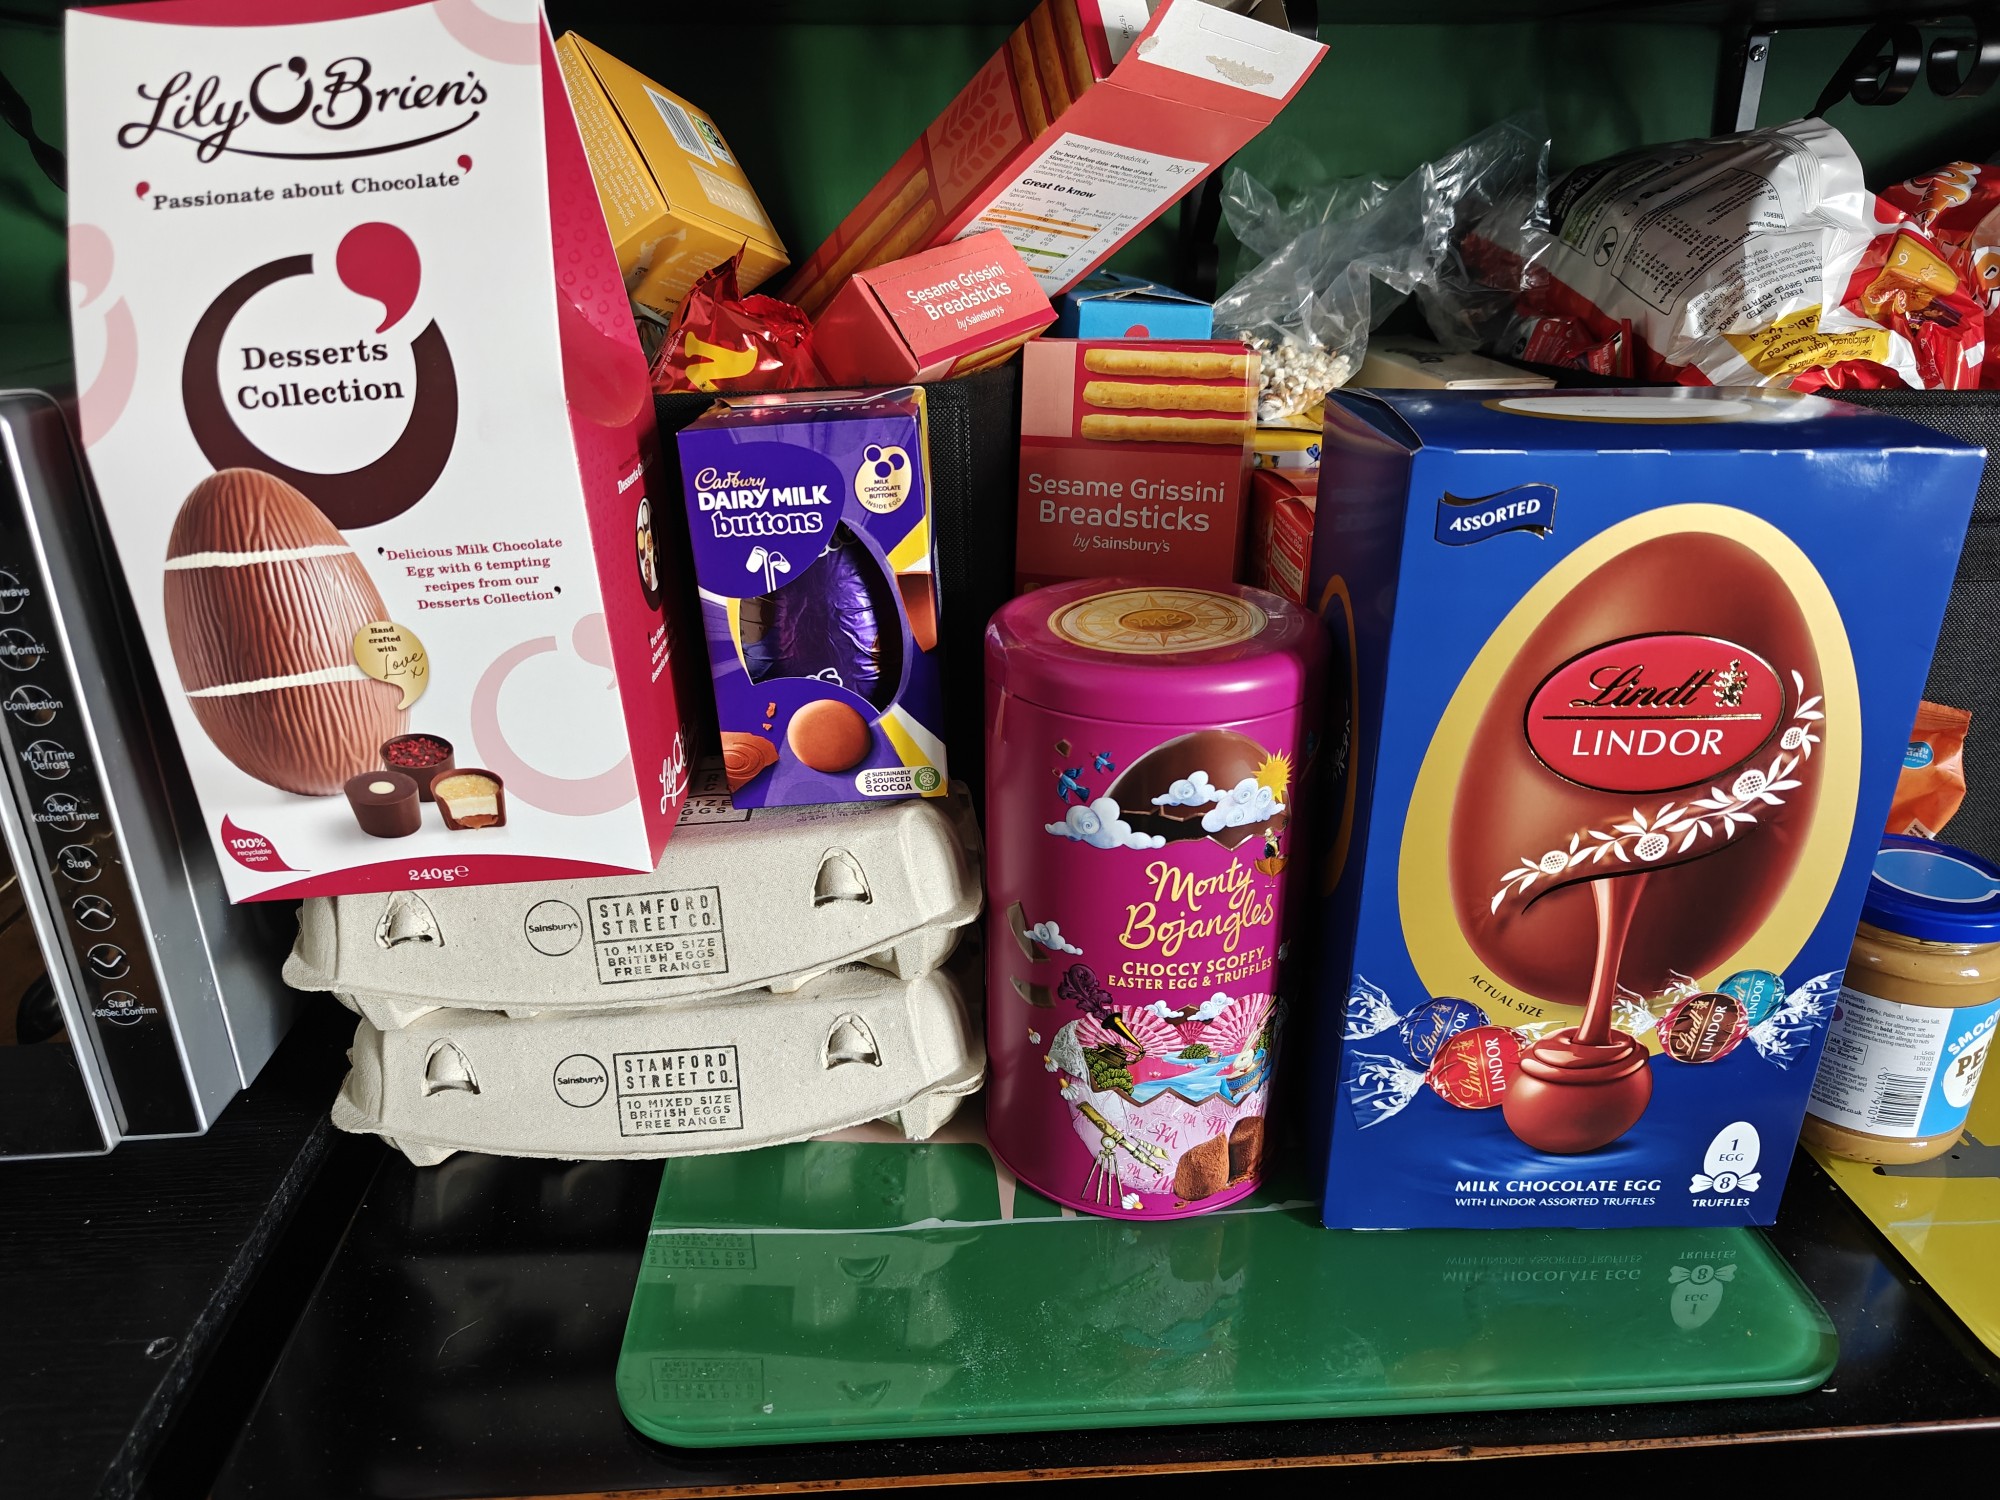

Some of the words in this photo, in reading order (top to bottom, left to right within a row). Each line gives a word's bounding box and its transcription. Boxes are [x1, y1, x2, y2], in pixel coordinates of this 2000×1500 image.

[118, 71, 249, 163] Lily
[1064, 140, 1090, 152] Sesame
[1113, 151, 1150, 164] breadsticks
[153, 188, 274, 210] Passionate
[283, 181, 344, 200] about
[352, 173, 459, 193] Chocolate
[1022, 178, 1053, 190] Great
[1055, 184, 1065, 192] to
[1066, 187, 1096, 198] know
[907, 279, 960, 304] Sesame
[958, 261, 1005, 286] Grissini
[1774, 280, 1802, 294] SHAPED
[923, 282, 1011, 321] Breadsticks
[1741, 292, 1772, 311] POTATO
[1779, 287, 1804, 301] READY
[956, 318, 968, 331] by
[965, 304, 1004, 325] Sainsbury's
[1715, 310, 1740, 332] SNACK
[241, 338, 388, 370] Desserts
[237, 379, 405, 410] Collection
[716, 409, 791, 419] HAPPY
[803, 404, 886, 413] EASTER
[694, 467, 766, 492] Cadbury
[1028, 473, 1123, 498] Sesame
[1130, 479, 1225, 503] Grissini
[698, 488, 770, 511] DAIRY
[773, 485, 832, 507] MILK
[865, 500, 887, 509] INSIDE
[889, 498, 902, 508] EGG
[712, 511, 824, 538] buttons
[1039, 500, 1210, 532] Breadsticks
[1449, 498, 1541, 533] ASSORTED
[387, 548, 453, 561] Delicious
[457, 544, 489, 556] Milk
[493, 538, 562, 553] Chocolate
[1072, 533, 1091, 552] by
[1092, 536, 1170, 554] Sainsbury's
[406, 566, 434, 578] Egg
[439, 562, 470, 574] with
[475, 562, 483, 571] 6
[487, 556, 551, 571] tempting
[425, 581, 475, 593] recipes
[479, 577, 512, 588] from
[516, 575, 539, 585] our
[418, 596, 480, 610] Desserts
[484, 591, 554, 605] Collection
[369, 635, 401, 644] crafted
[370, 626, 394, 634] Hand
[377, 645, 397, 653] with
[384, 652, 424, 679] Love
[1569, 665, 1717, 708] Lindt
[3, 700, 63, 711] Convection
[1572, 729, 1724, 756] LINDOR
[31, 760, 70, 770] Defrost
[865, 772, 873, 792] 100%
[873, 776, 911, 784] SOURCED
[874, 783, 912, 792] COCOA
[46, 802, 78, 812] Clock/
[31, 813, 68, 822] Kitchen
[68, 812, 100, 820] Timer
[230, 837, 267, 850] 100%
[236, 847, 272, 858] recyclable
[67, 859, 92, 869] Stop
[244, 855, 269, 863] carton
[1145, 857, 1254, 912] Monty
[600, 895, 709, 918] STAMFORD
[528, 923, 578, 934] Sainsbury's
[602, 916, 678, 936] STREET
[689, 912, 716, 928] CO.
[1118, 889, 1274, 957] Bojangles
[604, 947, 619, 956] 10
[627, 942, 674, 954] MIXED
[682, 938, 716, 949] SIZE
[608, 953, 668, 967] BRITISH
[676, 949, 715, 959] EGGS
[1122, 962, 1202, 976] CHOCCY
[1207, 946, 1265, 973] SCOFFY
[614, 966, 652, 977] FREE
[659, 960, 711, 972] RANGE
[1108, 975, 1163, 990] EASTER
[1168, 977, 1198, 990] EGG
[1202, 975, 1211, 987] &
[1216, 957, 1272, 985] TRUFFLES
[108, 999, 134, 1008] Start/
[1469, 974, 1513, 1008] ACTUAL
[1515, 1002, 1545, 1018] SIZE
[1417, 1012, 1446, 1057] Lindt
[1676, 1008, 1703, 1055] Lindt
[1699, 1005, 1728, 1052] LINDOR
[624, 1053, 727, 1073] STAMFORD
[1485, 1037, 1506, 1092] LINDOR
[558, 1075, 604, 1085] Sainsbury's
[626, 1072, 697, 1089] STREET
[707, 1070, 733, 1084] CO.
[1457, 1051, 1484, 1098] Lindt
[627, 1101, 642, 1109] 10
[649, 1097, 693, 1108] MIXED
[700, 1095, 732, 1105] SIZE
[630, 1108, 686, 1120] BRITISH
[693, 1105, 731, 1116] EGGS
[636, 1119, 671, 1129] FREE
[678, 1116, 727, 1126] RANGE
[1730, 1138, 1739, 1151] 1
[1718, 1153, 1745, 1162] EGG
[1455, 1180, 1499, 1193] MILK
[1506, 1179, 1618, 1193] CHOCOLATE
[1623, 1179, 1662, 1192] EGG
[1719, 1176, 1730, 1189] 8
[1455, 1197, 1487, 1207] WITH
[1490, 1197, 1536, 1207] LINDOR
[1539, 1197, 1599, 1206] ASSORTED
[1602, 1197, 1656, 1206] TRUFFLES
[1691, 1197, 1750, 1207] TRUFFLES
